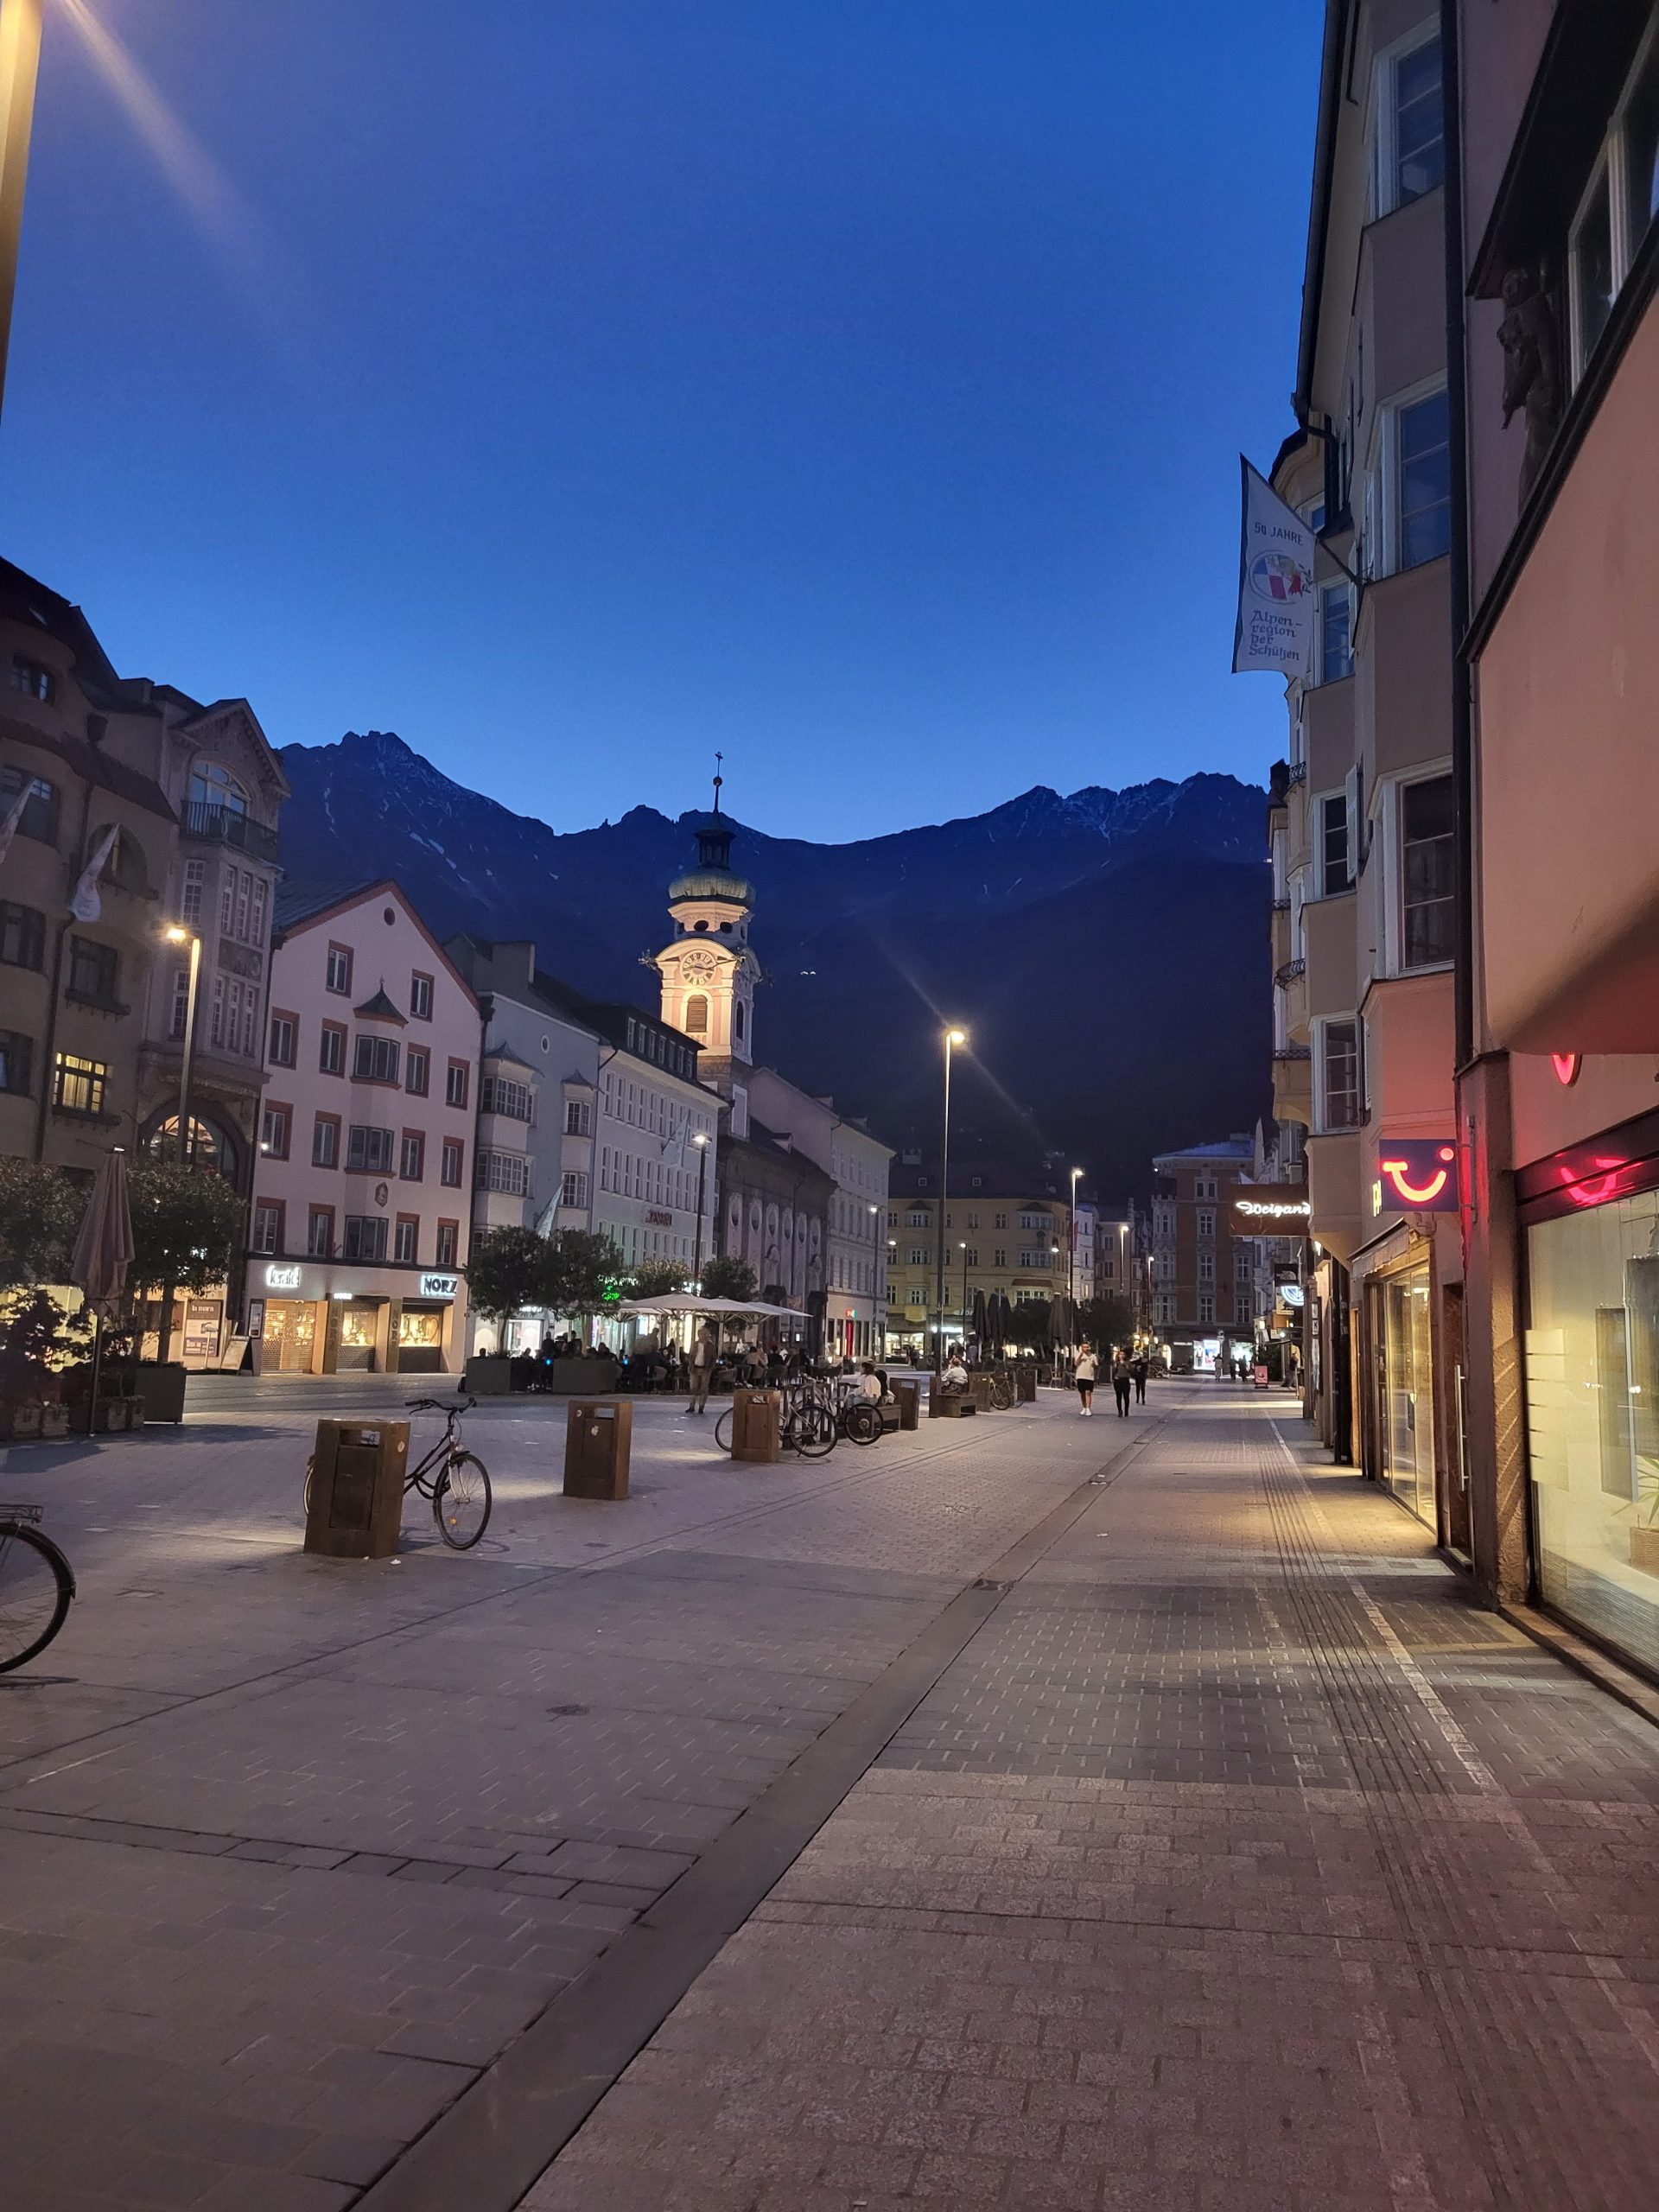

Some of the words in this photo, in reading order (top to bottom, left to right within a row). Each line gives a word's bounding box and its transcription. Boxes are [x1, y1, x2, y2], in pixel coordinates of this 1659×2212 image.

[1254, 521, 1267, 535] 50
[1270, 526, 1303, 546] JAHRE
[1236, 1201, 1312, 1218] Weigand
[423, 1276, 458, 1294] NORZ
